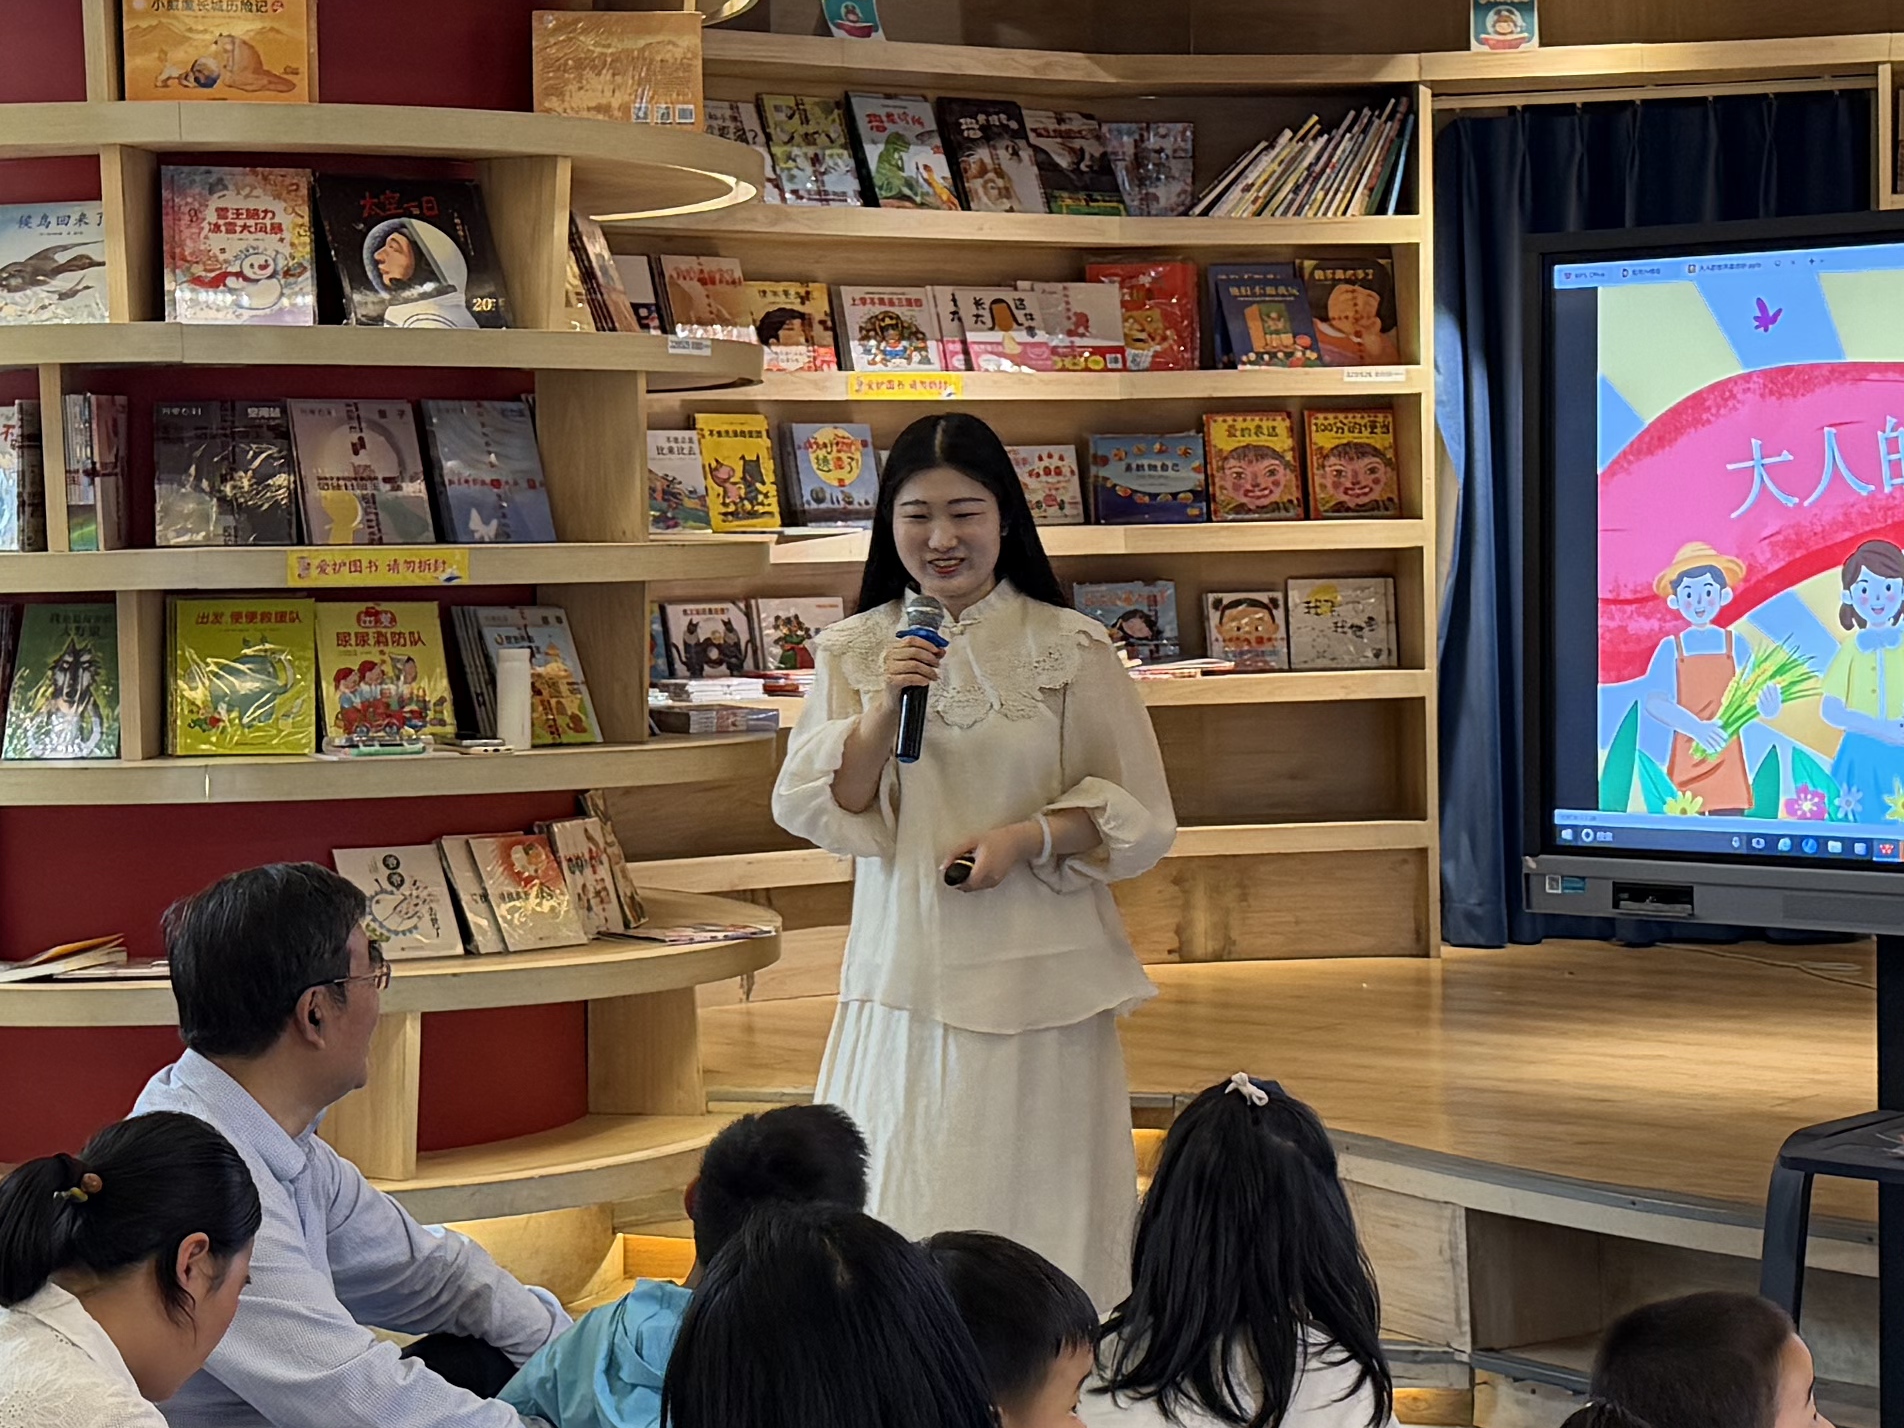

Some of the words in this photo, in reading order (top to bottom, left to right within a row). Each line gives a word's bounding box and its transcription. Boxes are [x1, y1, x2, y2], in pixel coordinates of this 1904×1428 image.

[360, 190, 440, 220] 太空一日
[1313, 420, 1391, 436] 100分的便当
[315, 558, 379, 575] 爱护图书
[386, 557, 447, 575] 请勿拆封
[334, 629, 428, 648] 尿尿消防队
